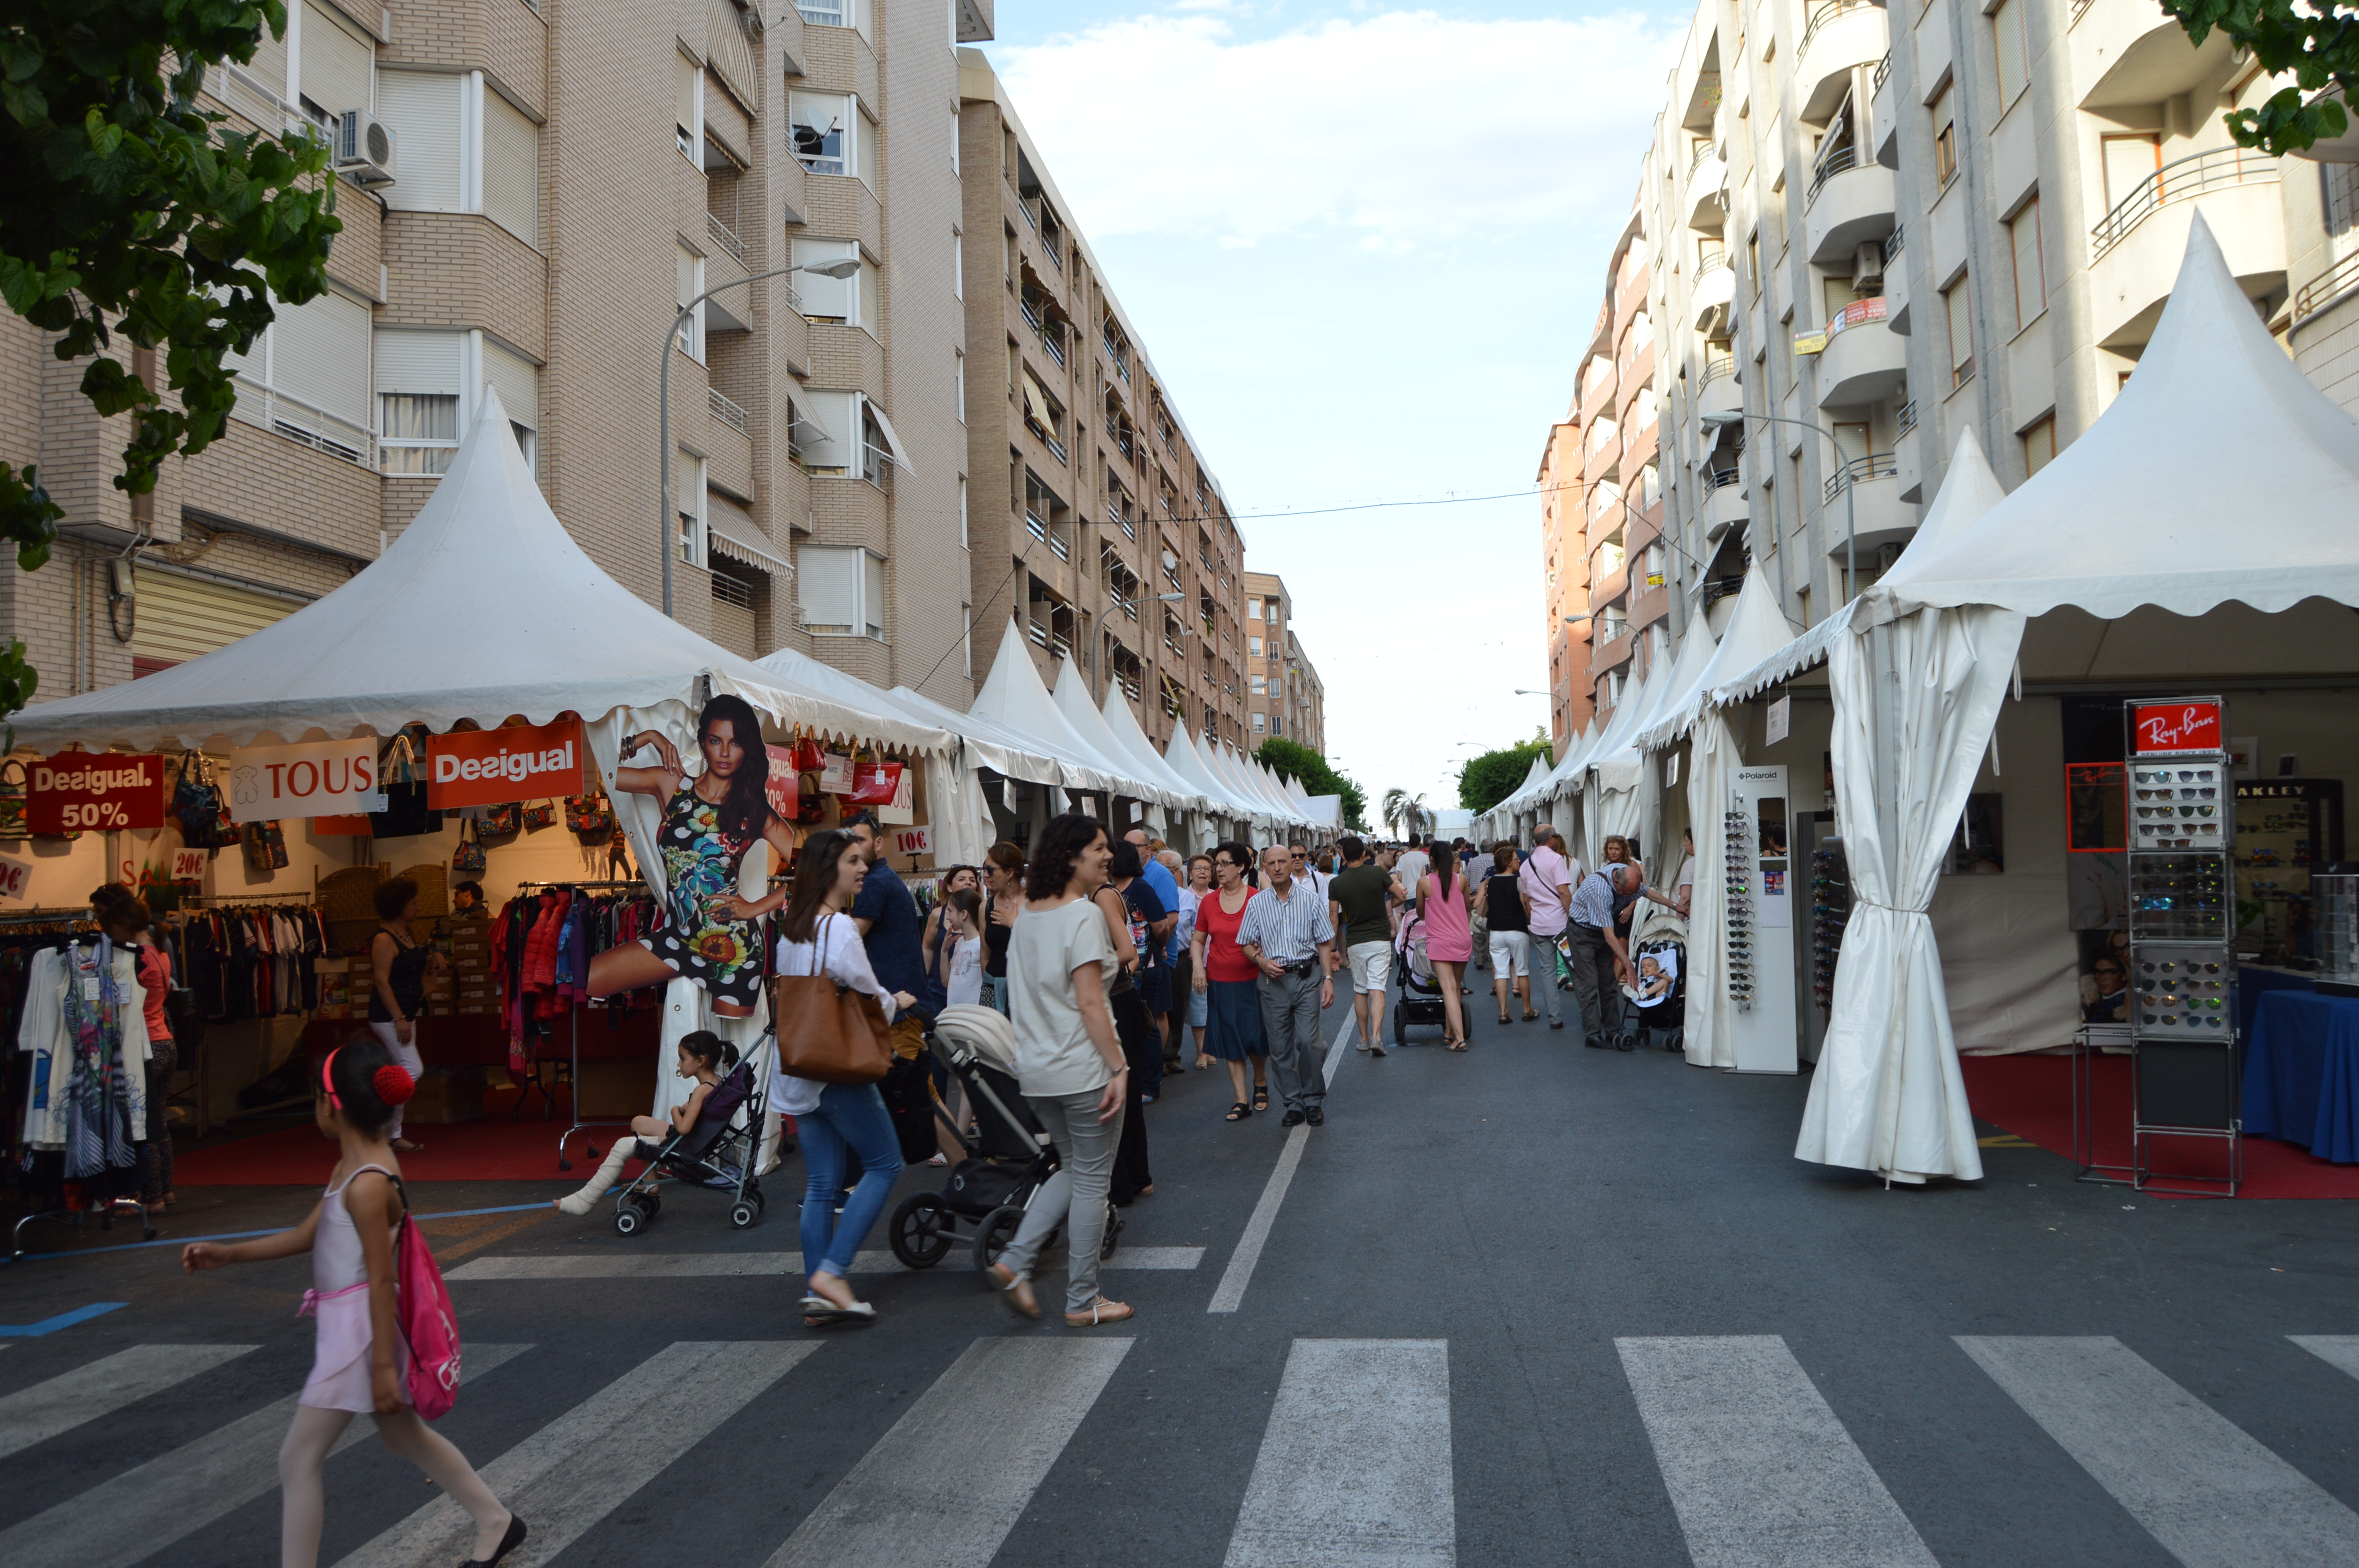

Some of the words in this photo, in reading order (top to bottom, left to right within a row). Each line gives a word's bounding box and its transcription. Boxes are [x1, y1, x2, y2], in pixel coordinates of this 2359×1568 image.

[1847, 309, 1865, 319] VENDE
[2139, 707, 2215, 745] Ray-Ban
[435, 740, 574, 783] Desigual
[265, 755, 372, 799] TOUS
[765, 788, 786, 813] 0%
[891, 782, 911, 810] OUS
[2237, 786, 2305, 796] AKLEY
[62, 802, 129, 827] 50%
[896, 830, 926, 853] 10€
[175, 852, 204, 874] 20€
